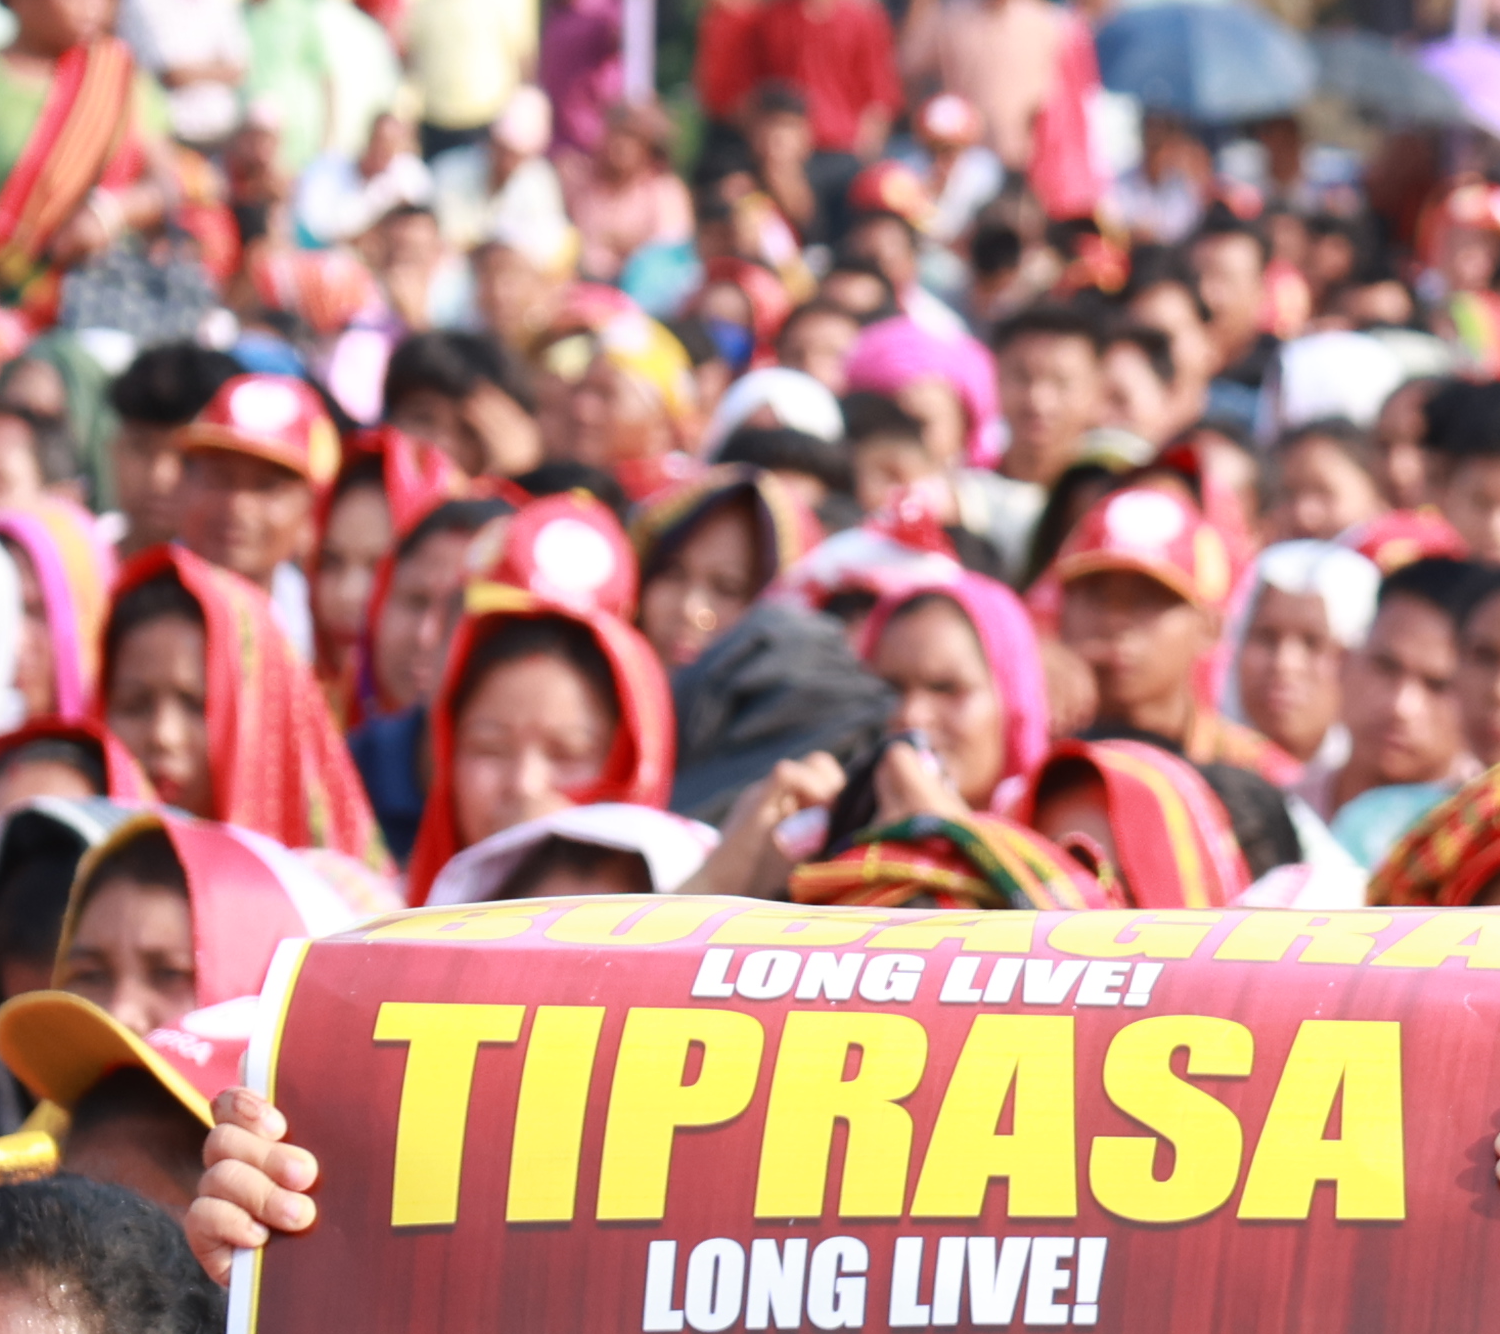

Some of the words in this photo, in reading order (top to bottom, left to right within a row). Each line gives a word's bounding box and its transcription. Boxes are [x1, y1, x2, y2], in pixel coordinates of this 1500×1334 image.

[691, 948, 926, 1003] LONG
[938, 955, 1165, 1007] LIVE!
[373, 1002, 1406, 1227] TIPRASA
[643, 1235, 869, 1333] LONG
[888, 1236, 1108, 1328] LIVE!
